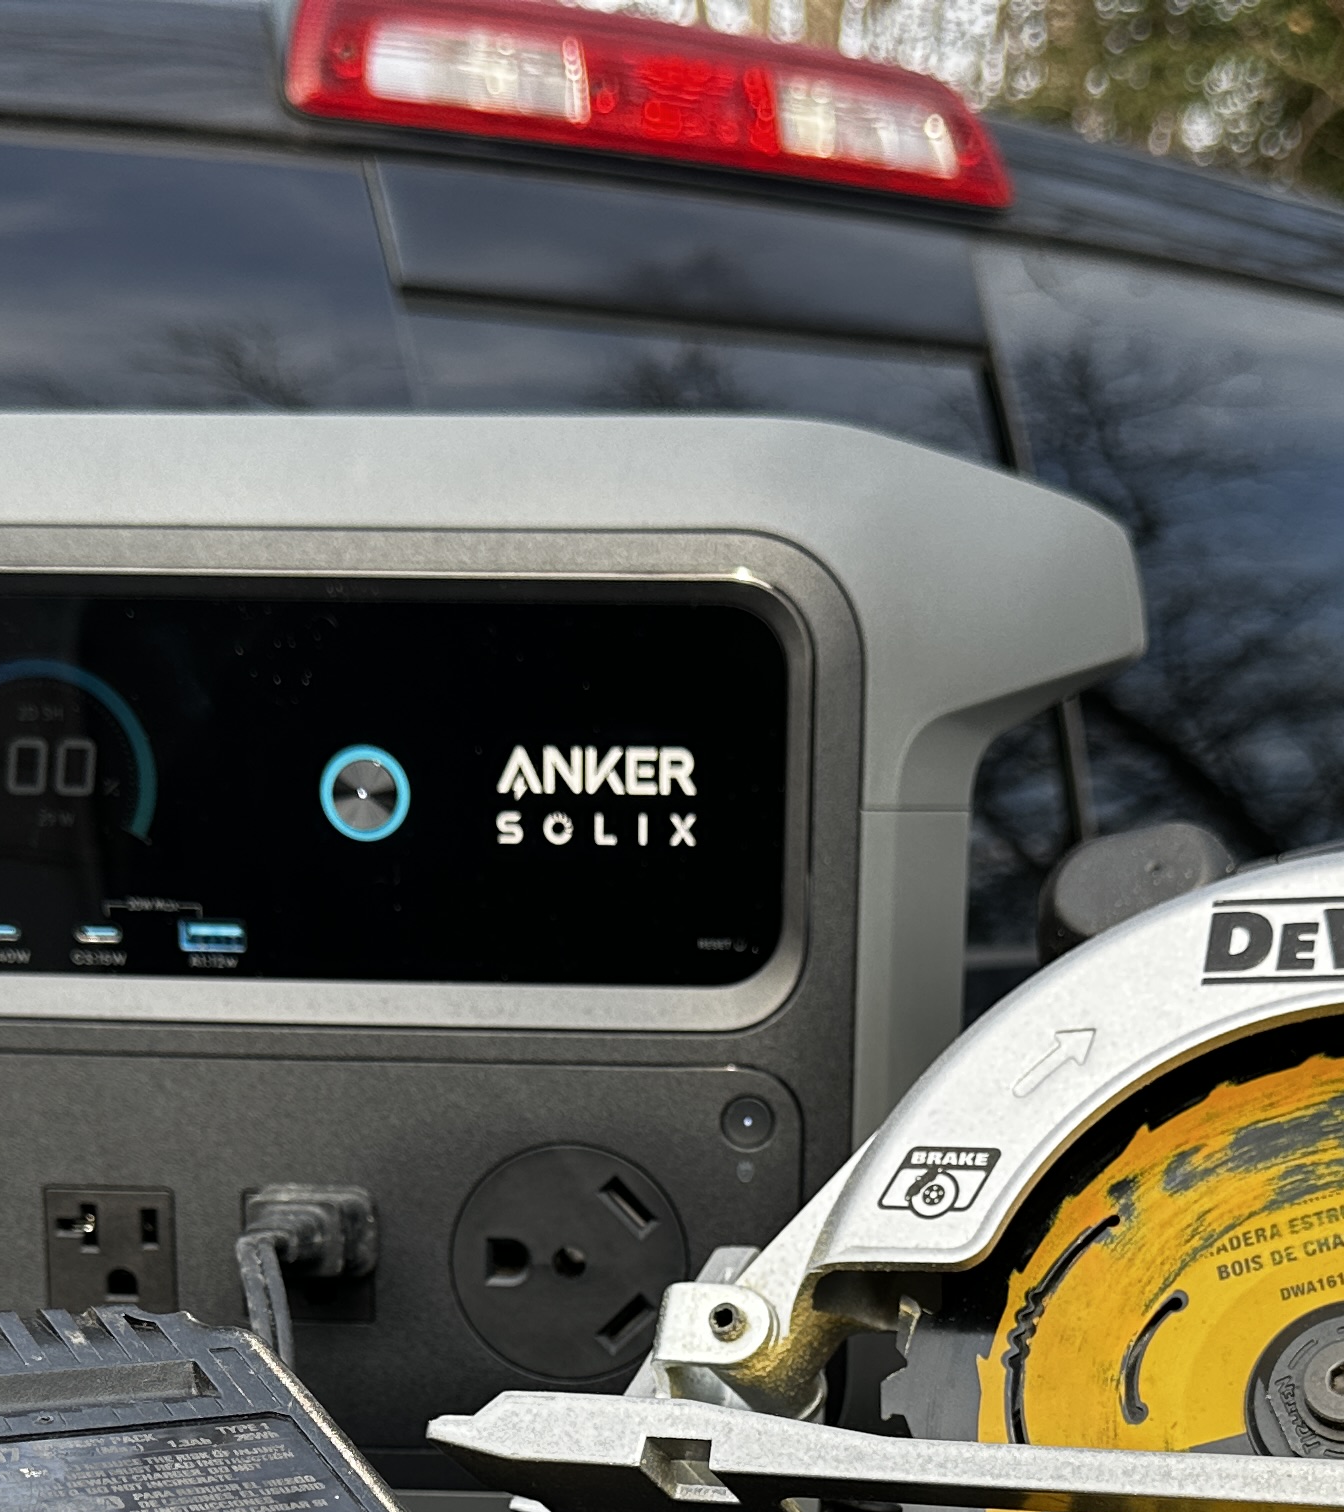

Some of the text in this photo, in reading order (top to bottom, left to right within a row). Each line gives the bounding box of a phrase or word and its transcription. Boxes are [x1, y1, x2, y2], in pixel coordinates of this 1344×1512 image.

[496, 744, 697, 798] ANKER
[496, 811, 697, 846] SOLIX
[910, 1151, 990, 1167] BRAKE
[1207, 1223, 1284, 1258] ADERA
[1216, 1254, 1264, 1282] BOIS
[1270, 1245, 1298, 1267] DE
[215, 1424, 258, 1433] TYPE
